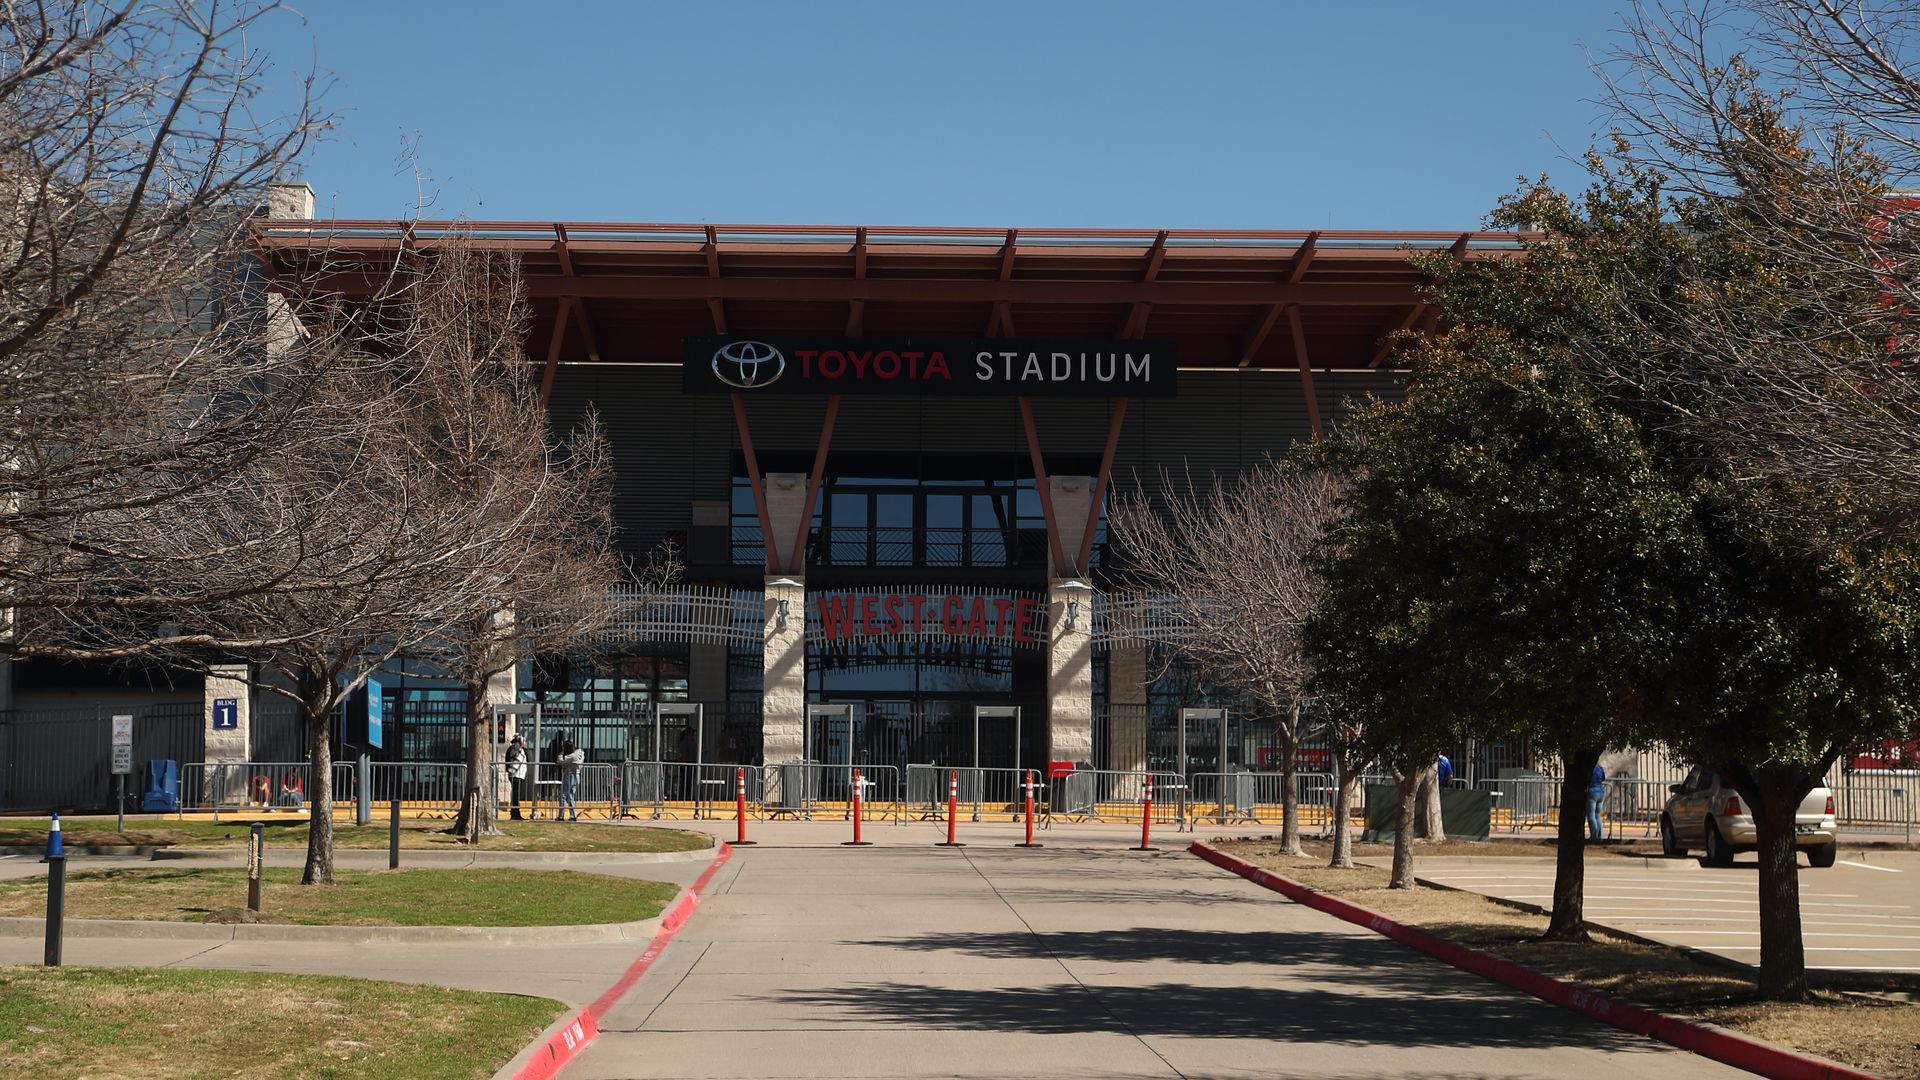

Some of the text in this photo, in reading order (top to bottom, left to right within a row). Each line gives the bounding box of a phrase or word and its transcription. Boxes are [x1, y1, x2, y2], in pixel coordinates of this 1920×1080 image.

[794, 350, 1152, 383] TOYOTA STADIUM
[818, 594, 1038, 643] WEST GATE
[221, 708, 231, 726] 1
